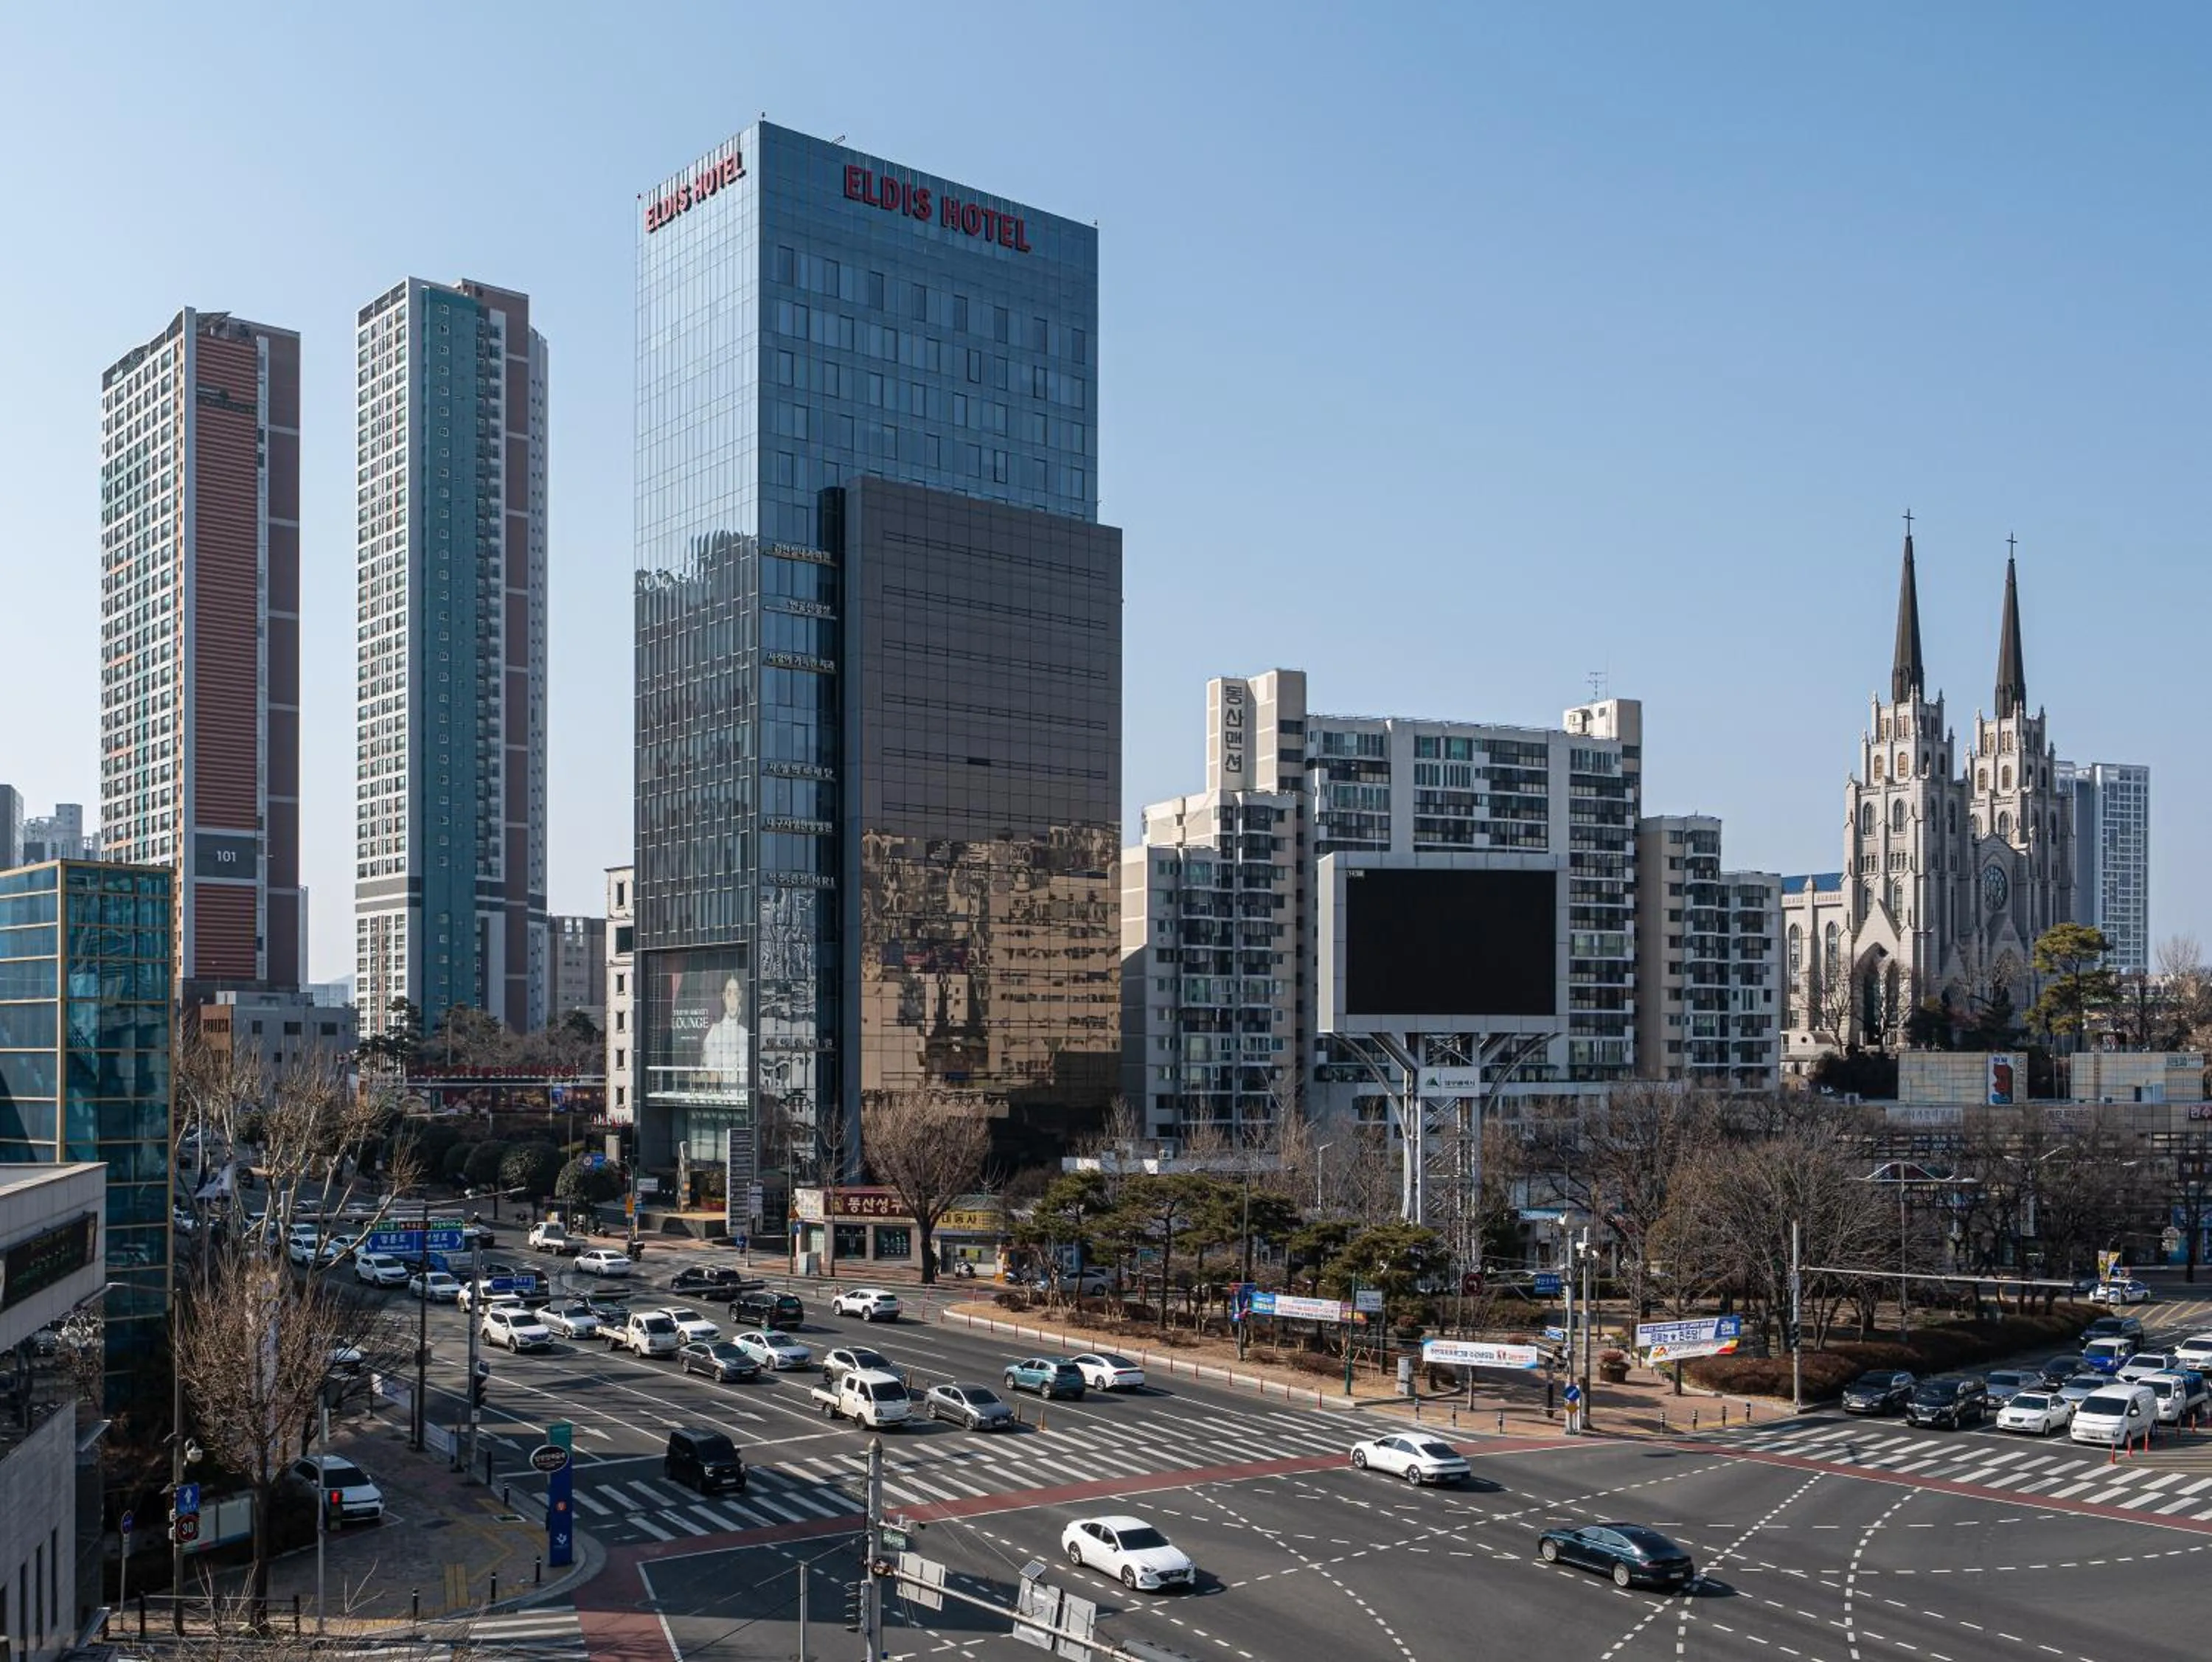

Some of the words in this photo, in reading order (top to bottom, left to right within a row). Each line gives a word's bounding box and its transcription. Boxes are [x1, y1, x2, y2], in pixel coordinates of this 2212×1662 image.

[644, 184, 692, 234] ELDIS
[692, 150, 746, 204] HOTEL
[844, 164, 933, 221] ELDIS
[941, 195, 1032, 252] HOTEL
[1225, 685, 1244, 773] 동산맨션
[216, 850, 237, 862] 101
[181, 1522, 194, 1534] 30
